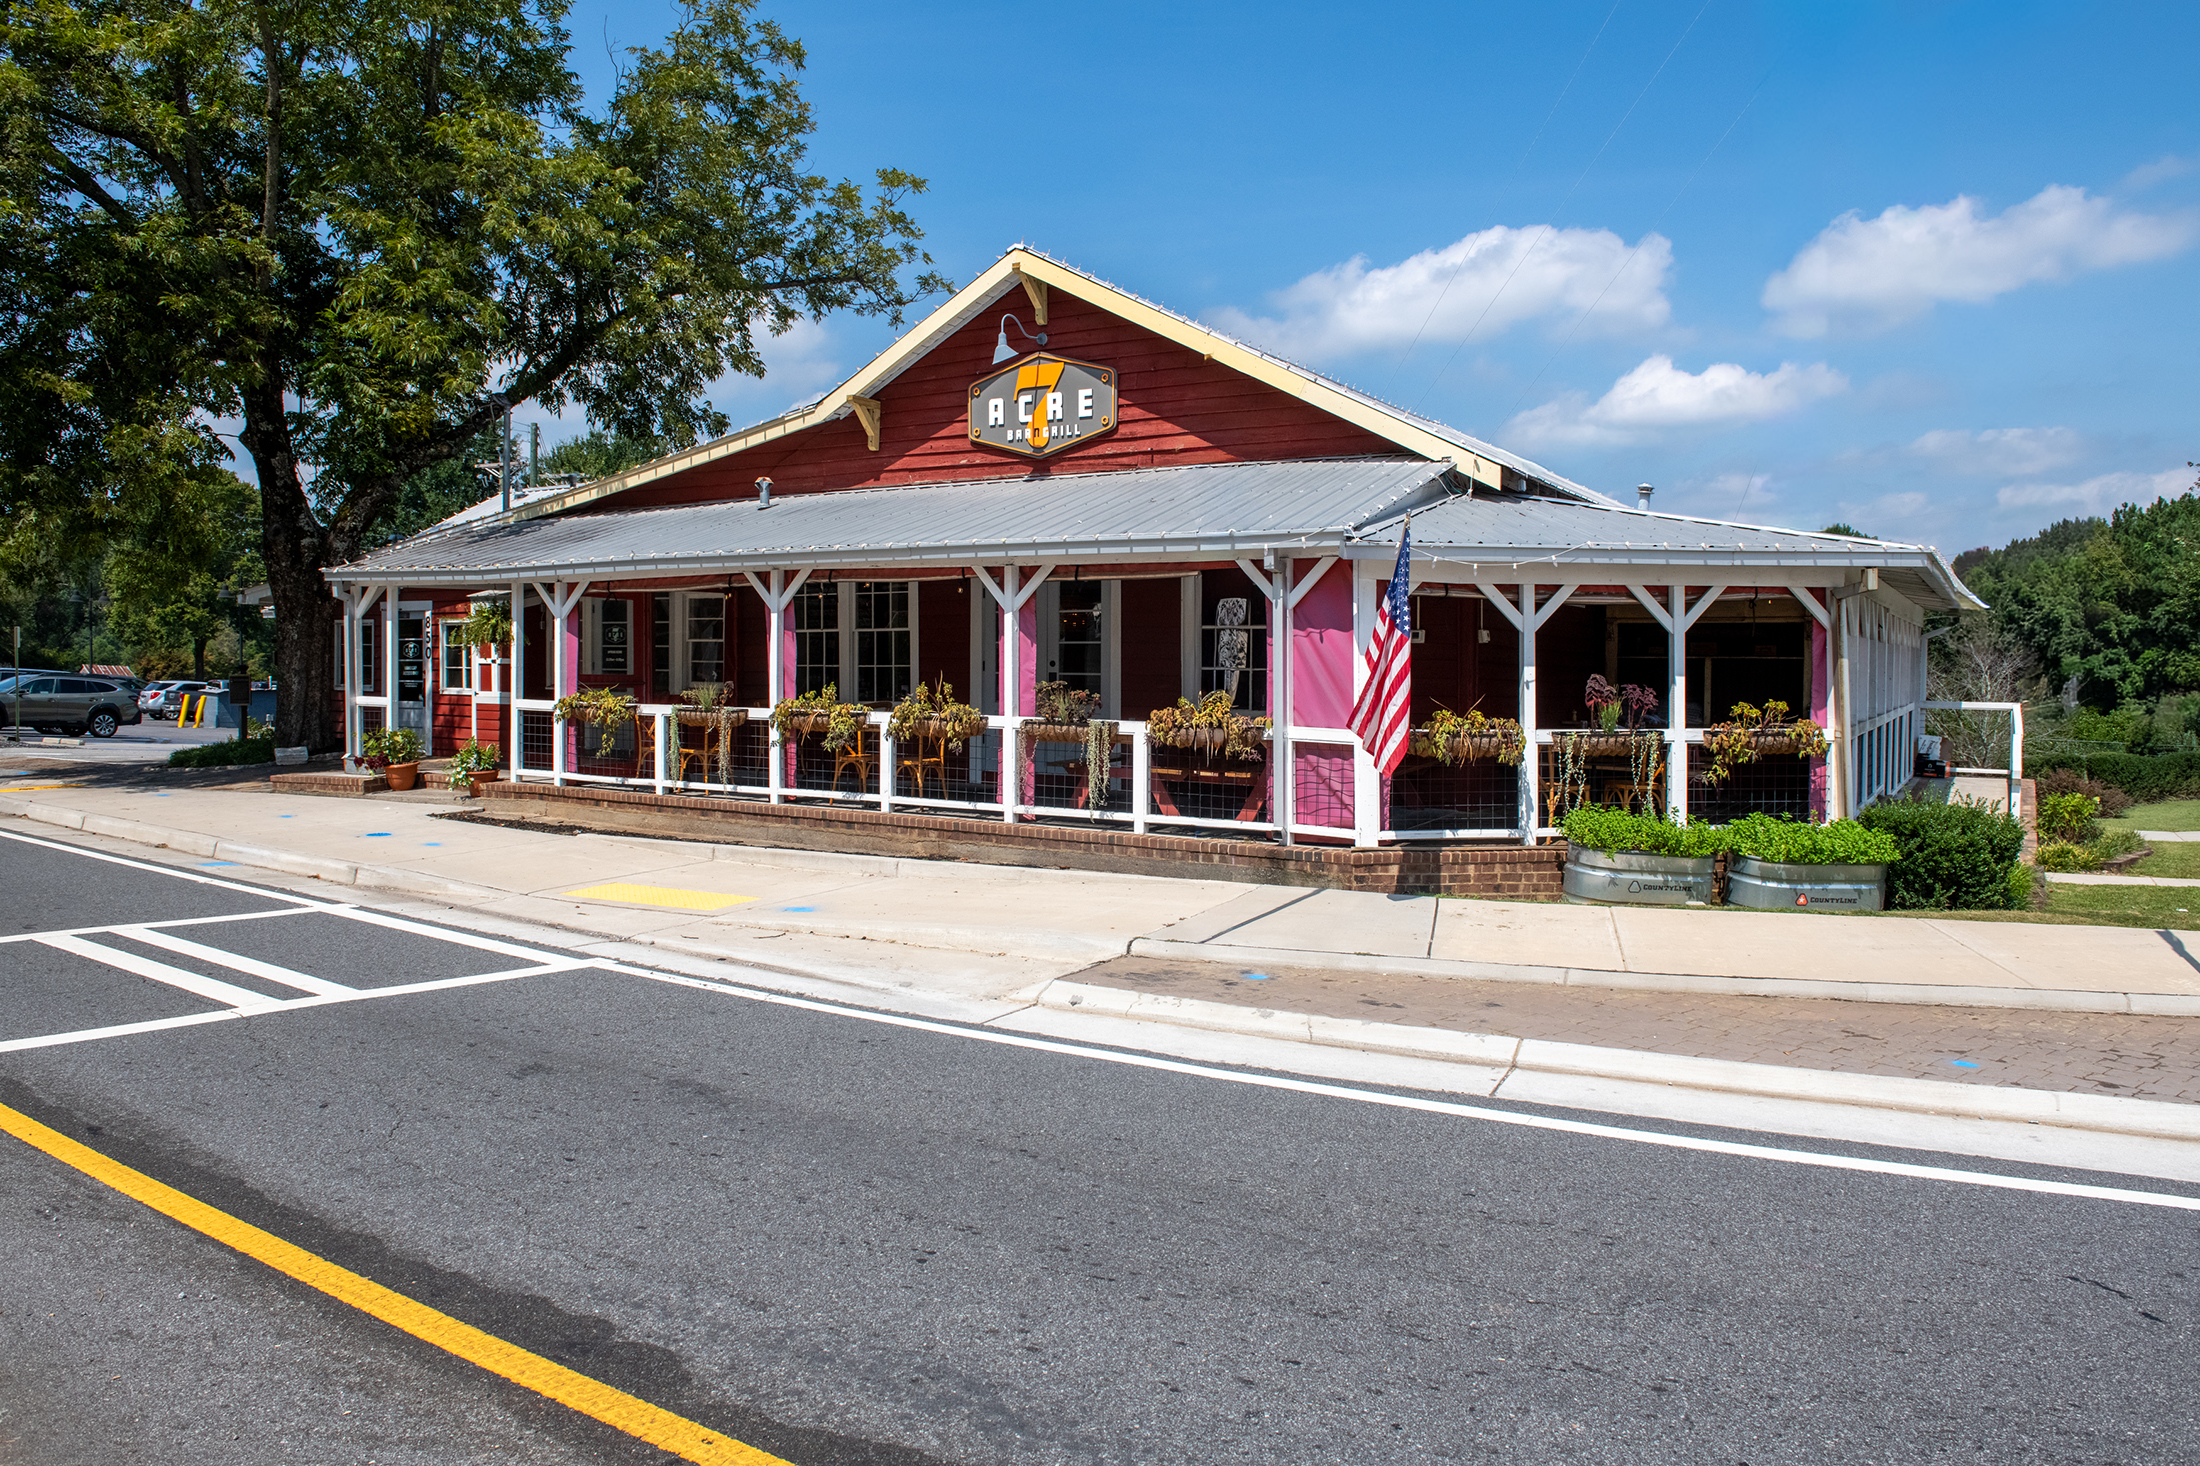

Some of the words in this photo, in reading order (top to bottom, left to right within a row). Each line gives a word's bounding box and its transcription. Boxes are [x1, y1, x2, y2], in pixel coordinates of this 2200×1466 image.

[988, 388, 1093, 427] ACRE
[1013, 361, 1065, 448] 7
[1007, 428, 1031, 442] BAR
[1042, 423, 1081, 438] GRILL
[424, 615, 432, 660] 850
